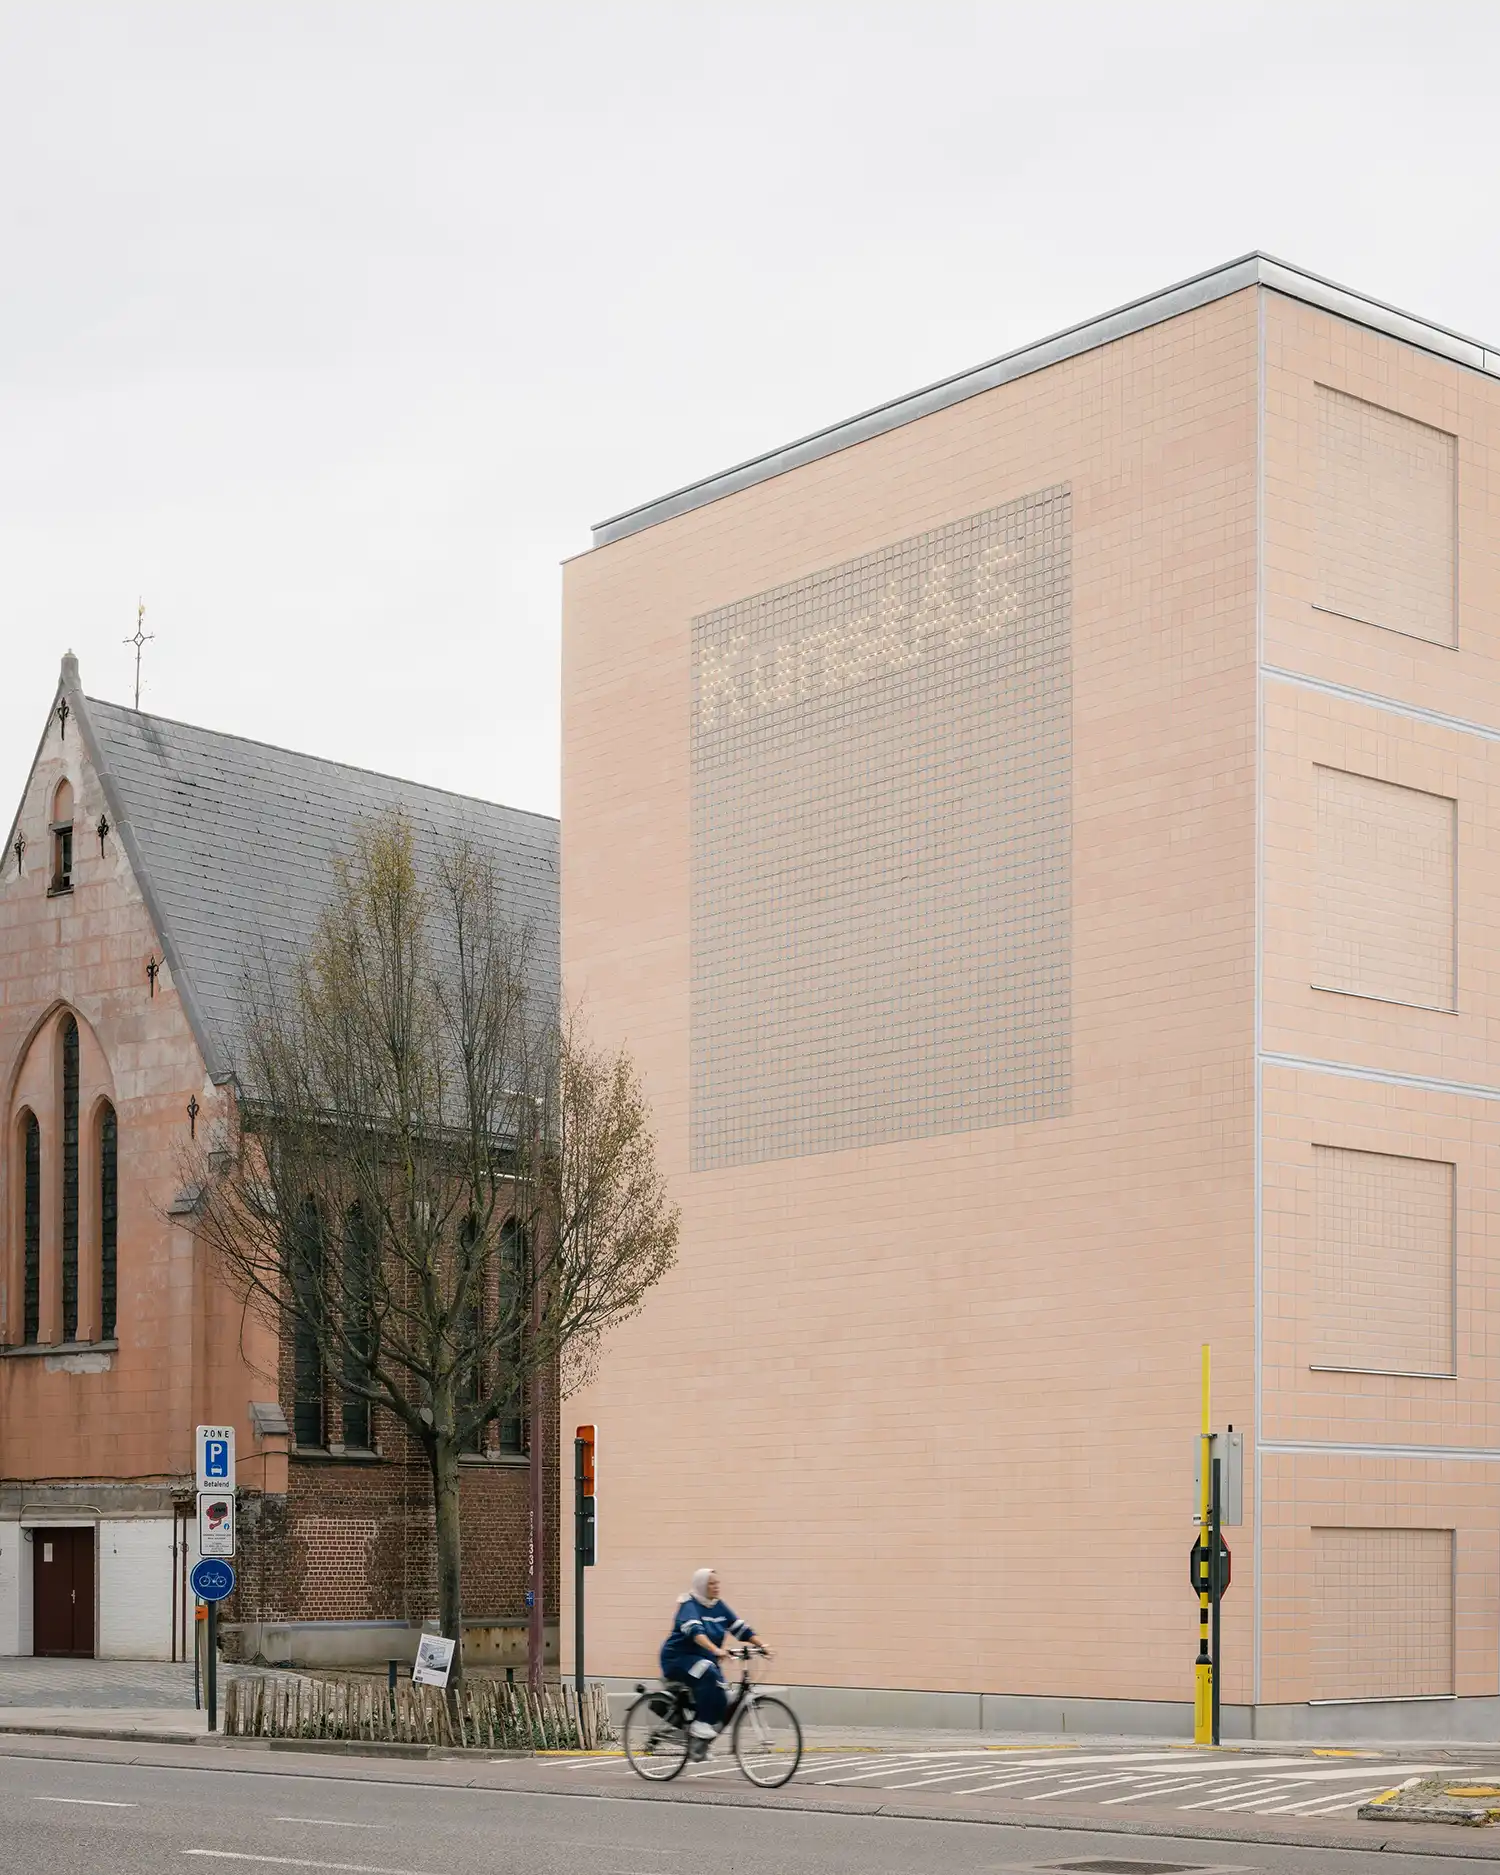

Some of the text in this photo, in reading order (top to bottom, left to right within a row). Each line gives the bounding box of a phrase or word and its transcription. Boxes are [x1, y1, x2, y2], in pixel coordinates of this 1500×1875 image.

[203, 1430, 229, 1438] ZONE
[211, 1443, 222, 1463] P
[203, 1480, 229, 1488] Betalend
